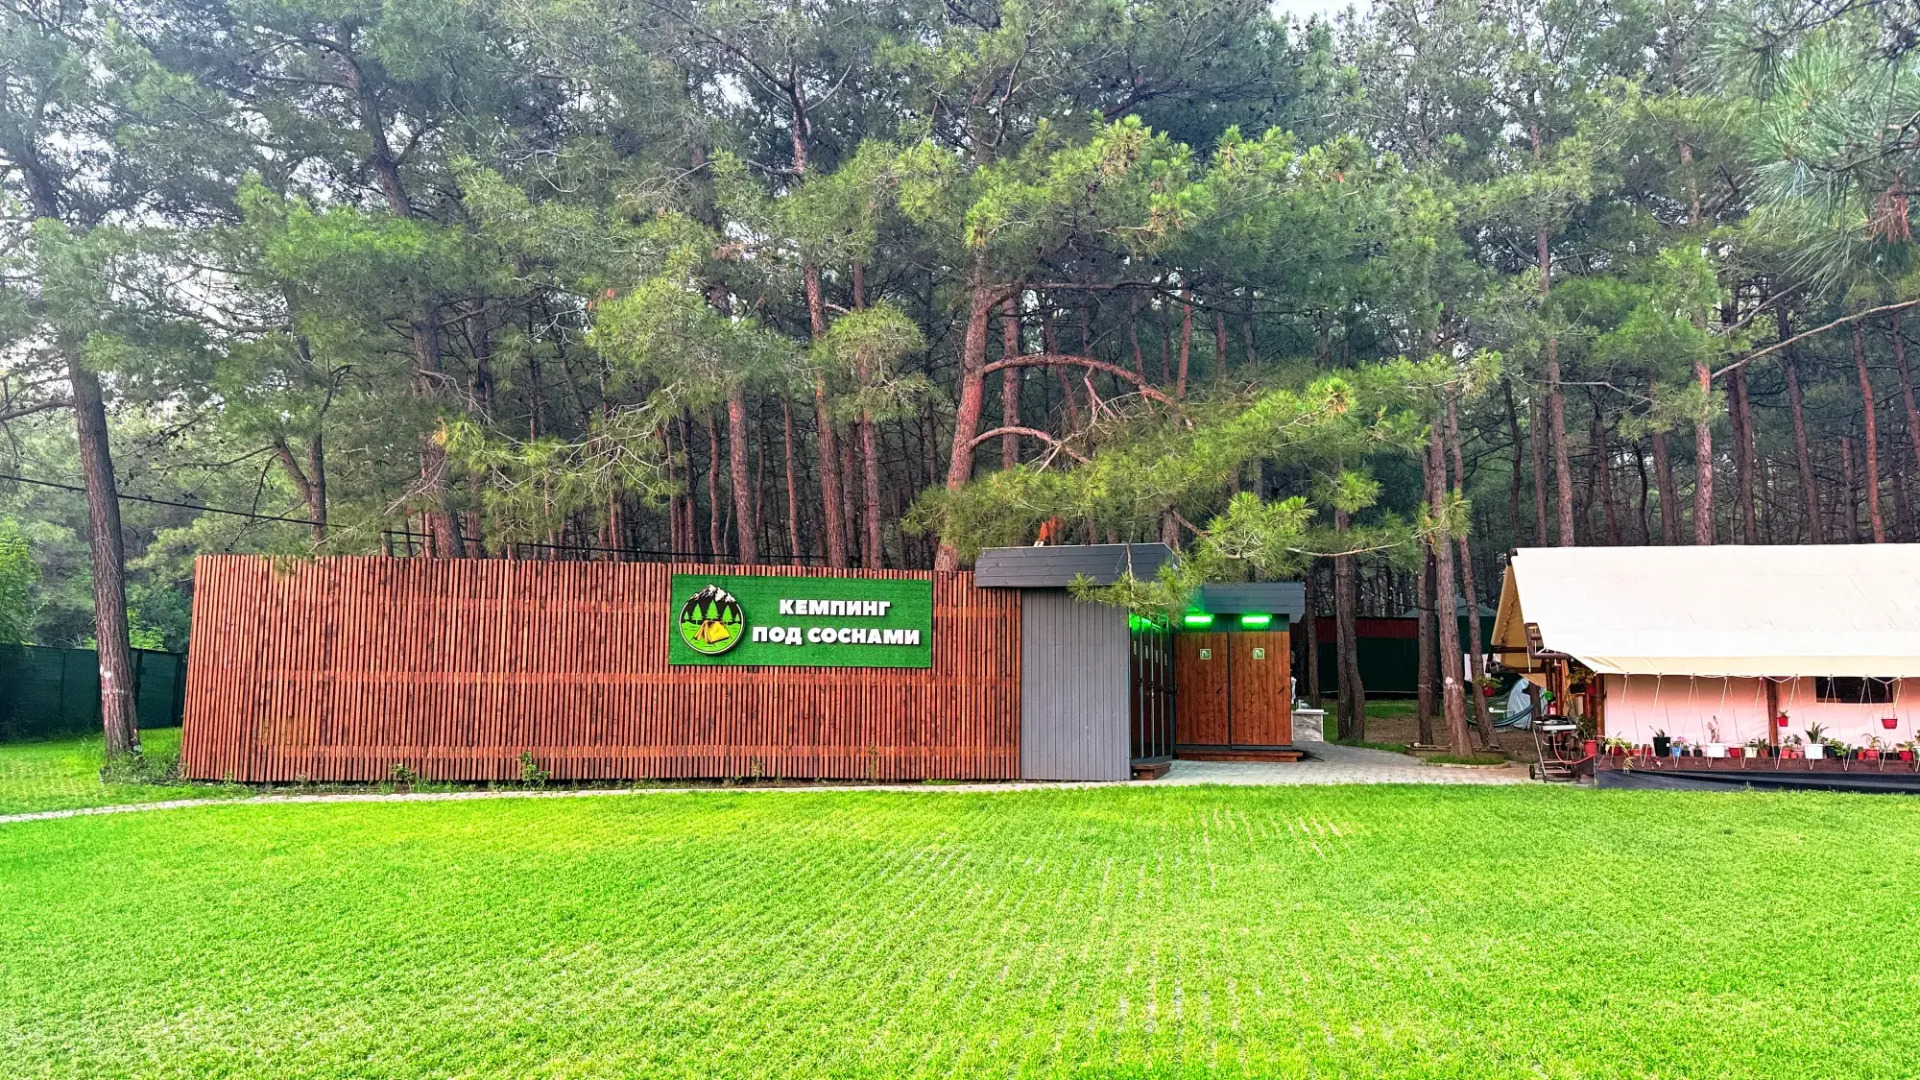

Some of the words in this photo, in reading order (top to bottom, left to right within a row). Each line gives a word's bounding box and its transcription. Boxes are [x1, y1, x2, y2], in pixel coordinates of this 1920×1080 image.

[779, 599, 891, 617] КЕМПИНГ
[752, 626, 803, 646] ПОД
[807, 627, 920, 646] СОСНАМИ
